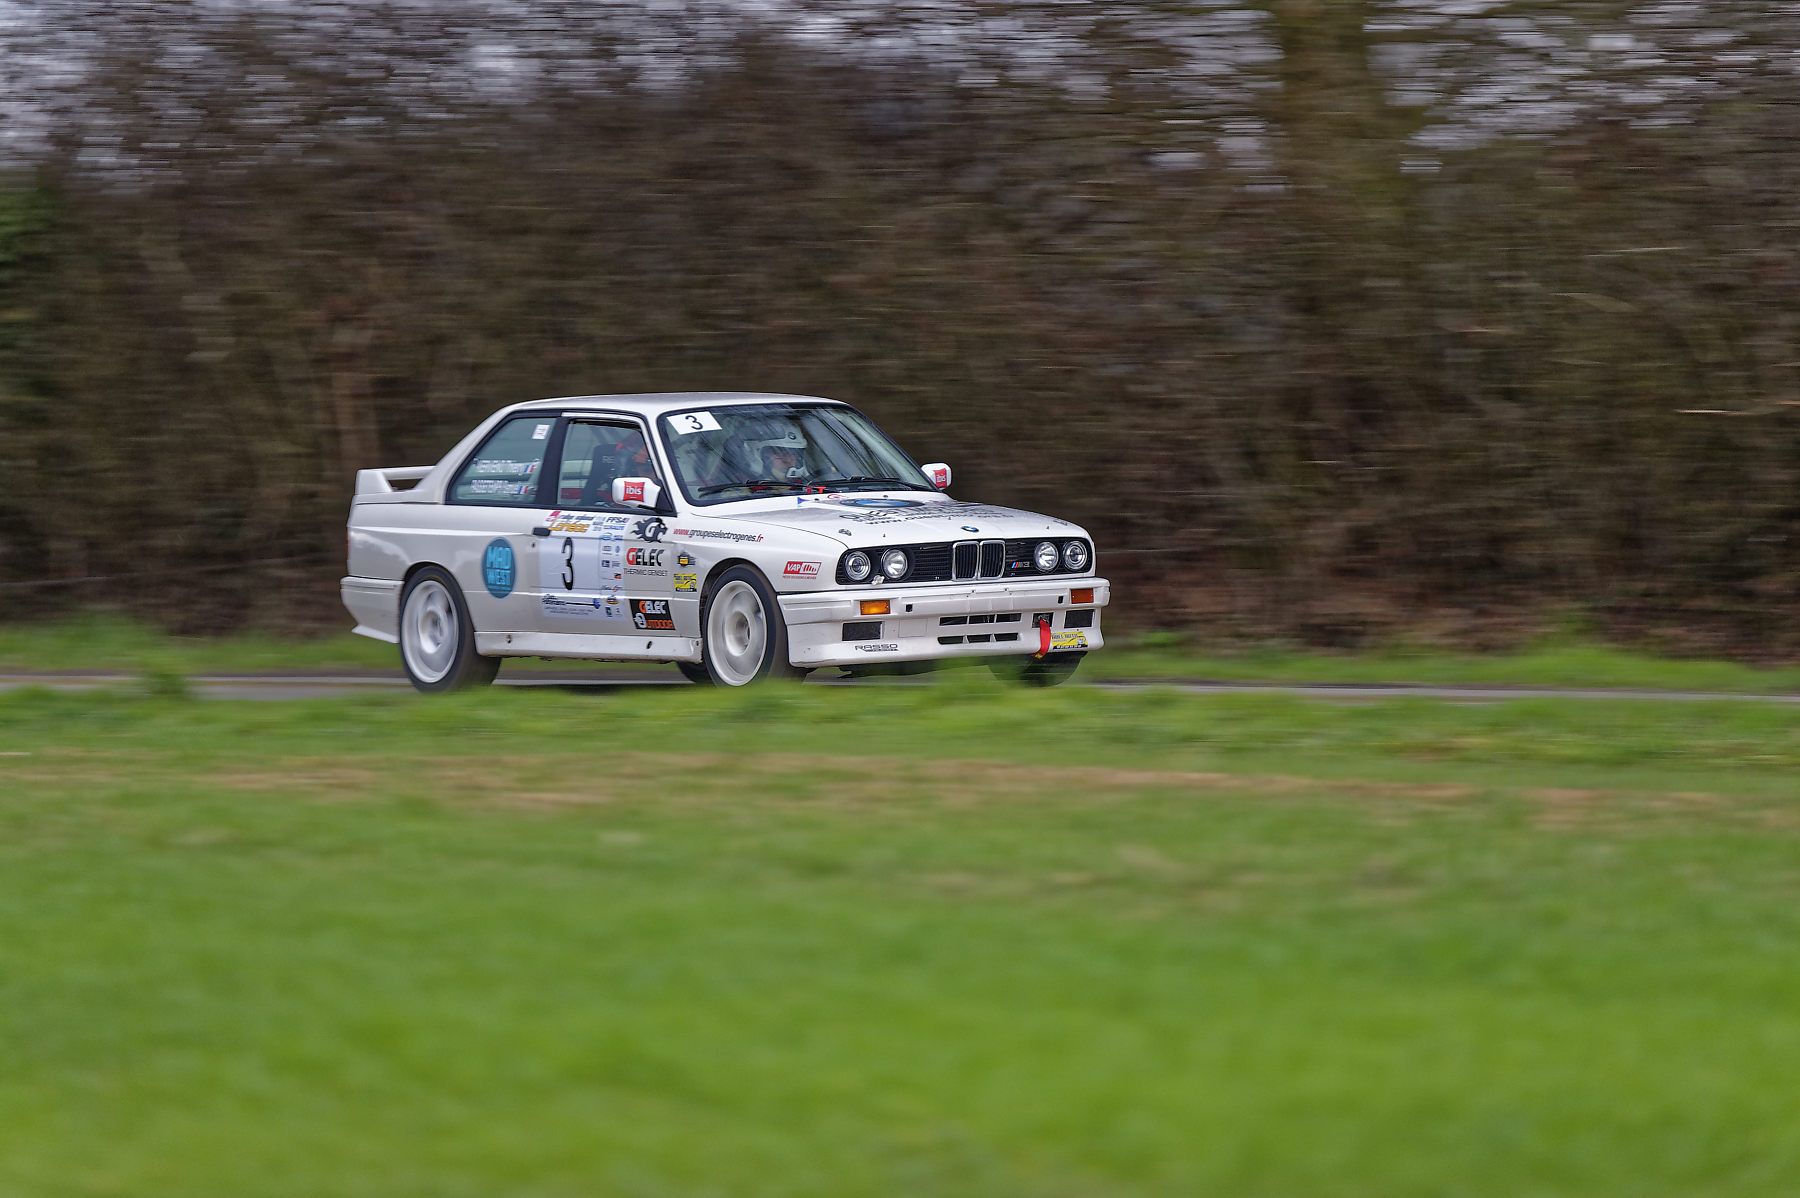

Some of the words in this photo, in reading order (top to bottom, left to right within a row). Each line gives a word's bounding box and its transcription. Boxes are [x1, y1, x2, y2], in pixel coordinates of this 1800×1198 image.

[685, 415, 703, 430] 3
[626, 485, 642, 495] ibis
[673, 528, 764, 543] www.groupeselectrogenes.fr
[487, 545, 511, 570] MAD
[561, 537, 573, 590] 3
[626, 547, 665, 567] GELEC
[787, 563, 801, 572] VAP
[639, 600, 667, 614] GELEC
